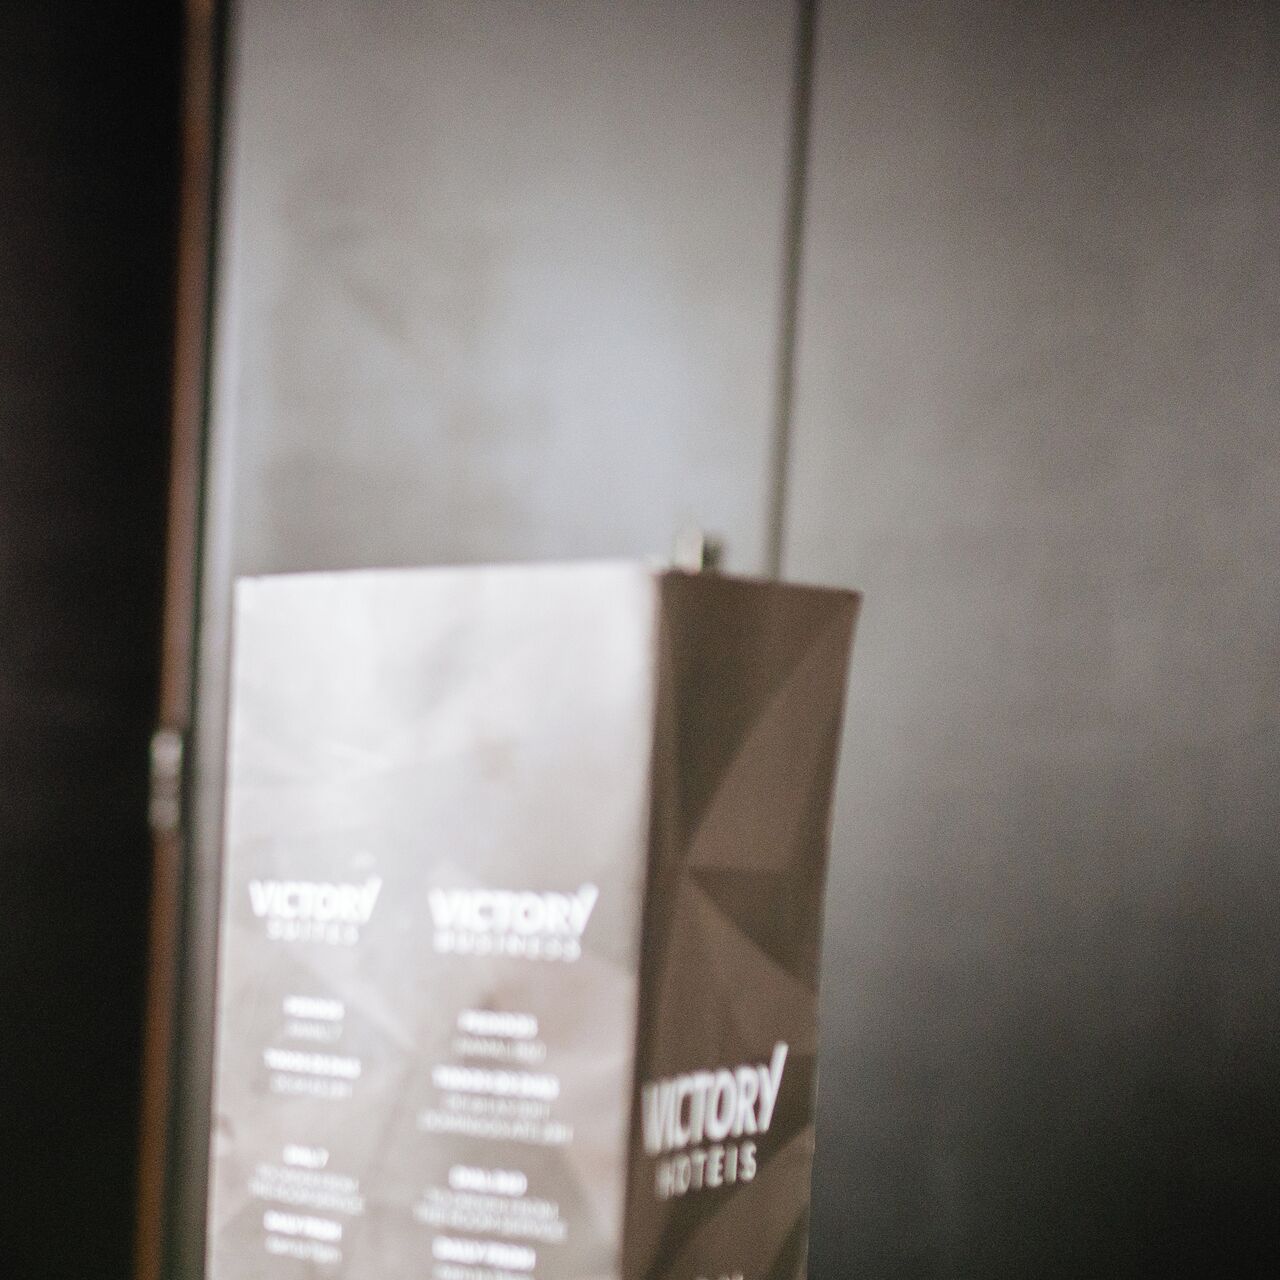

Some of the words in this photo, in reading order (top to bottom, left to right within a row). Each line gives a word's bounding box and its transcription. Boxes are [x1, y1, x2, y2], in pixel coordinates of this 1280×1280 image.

[249, 874, 382, 924] VICTORY
[428, 883, 599, 935] VICTORY
[642, 1040, 789, 1156] VICTORY
[655, 1140, 757, 1199] HOTELS
